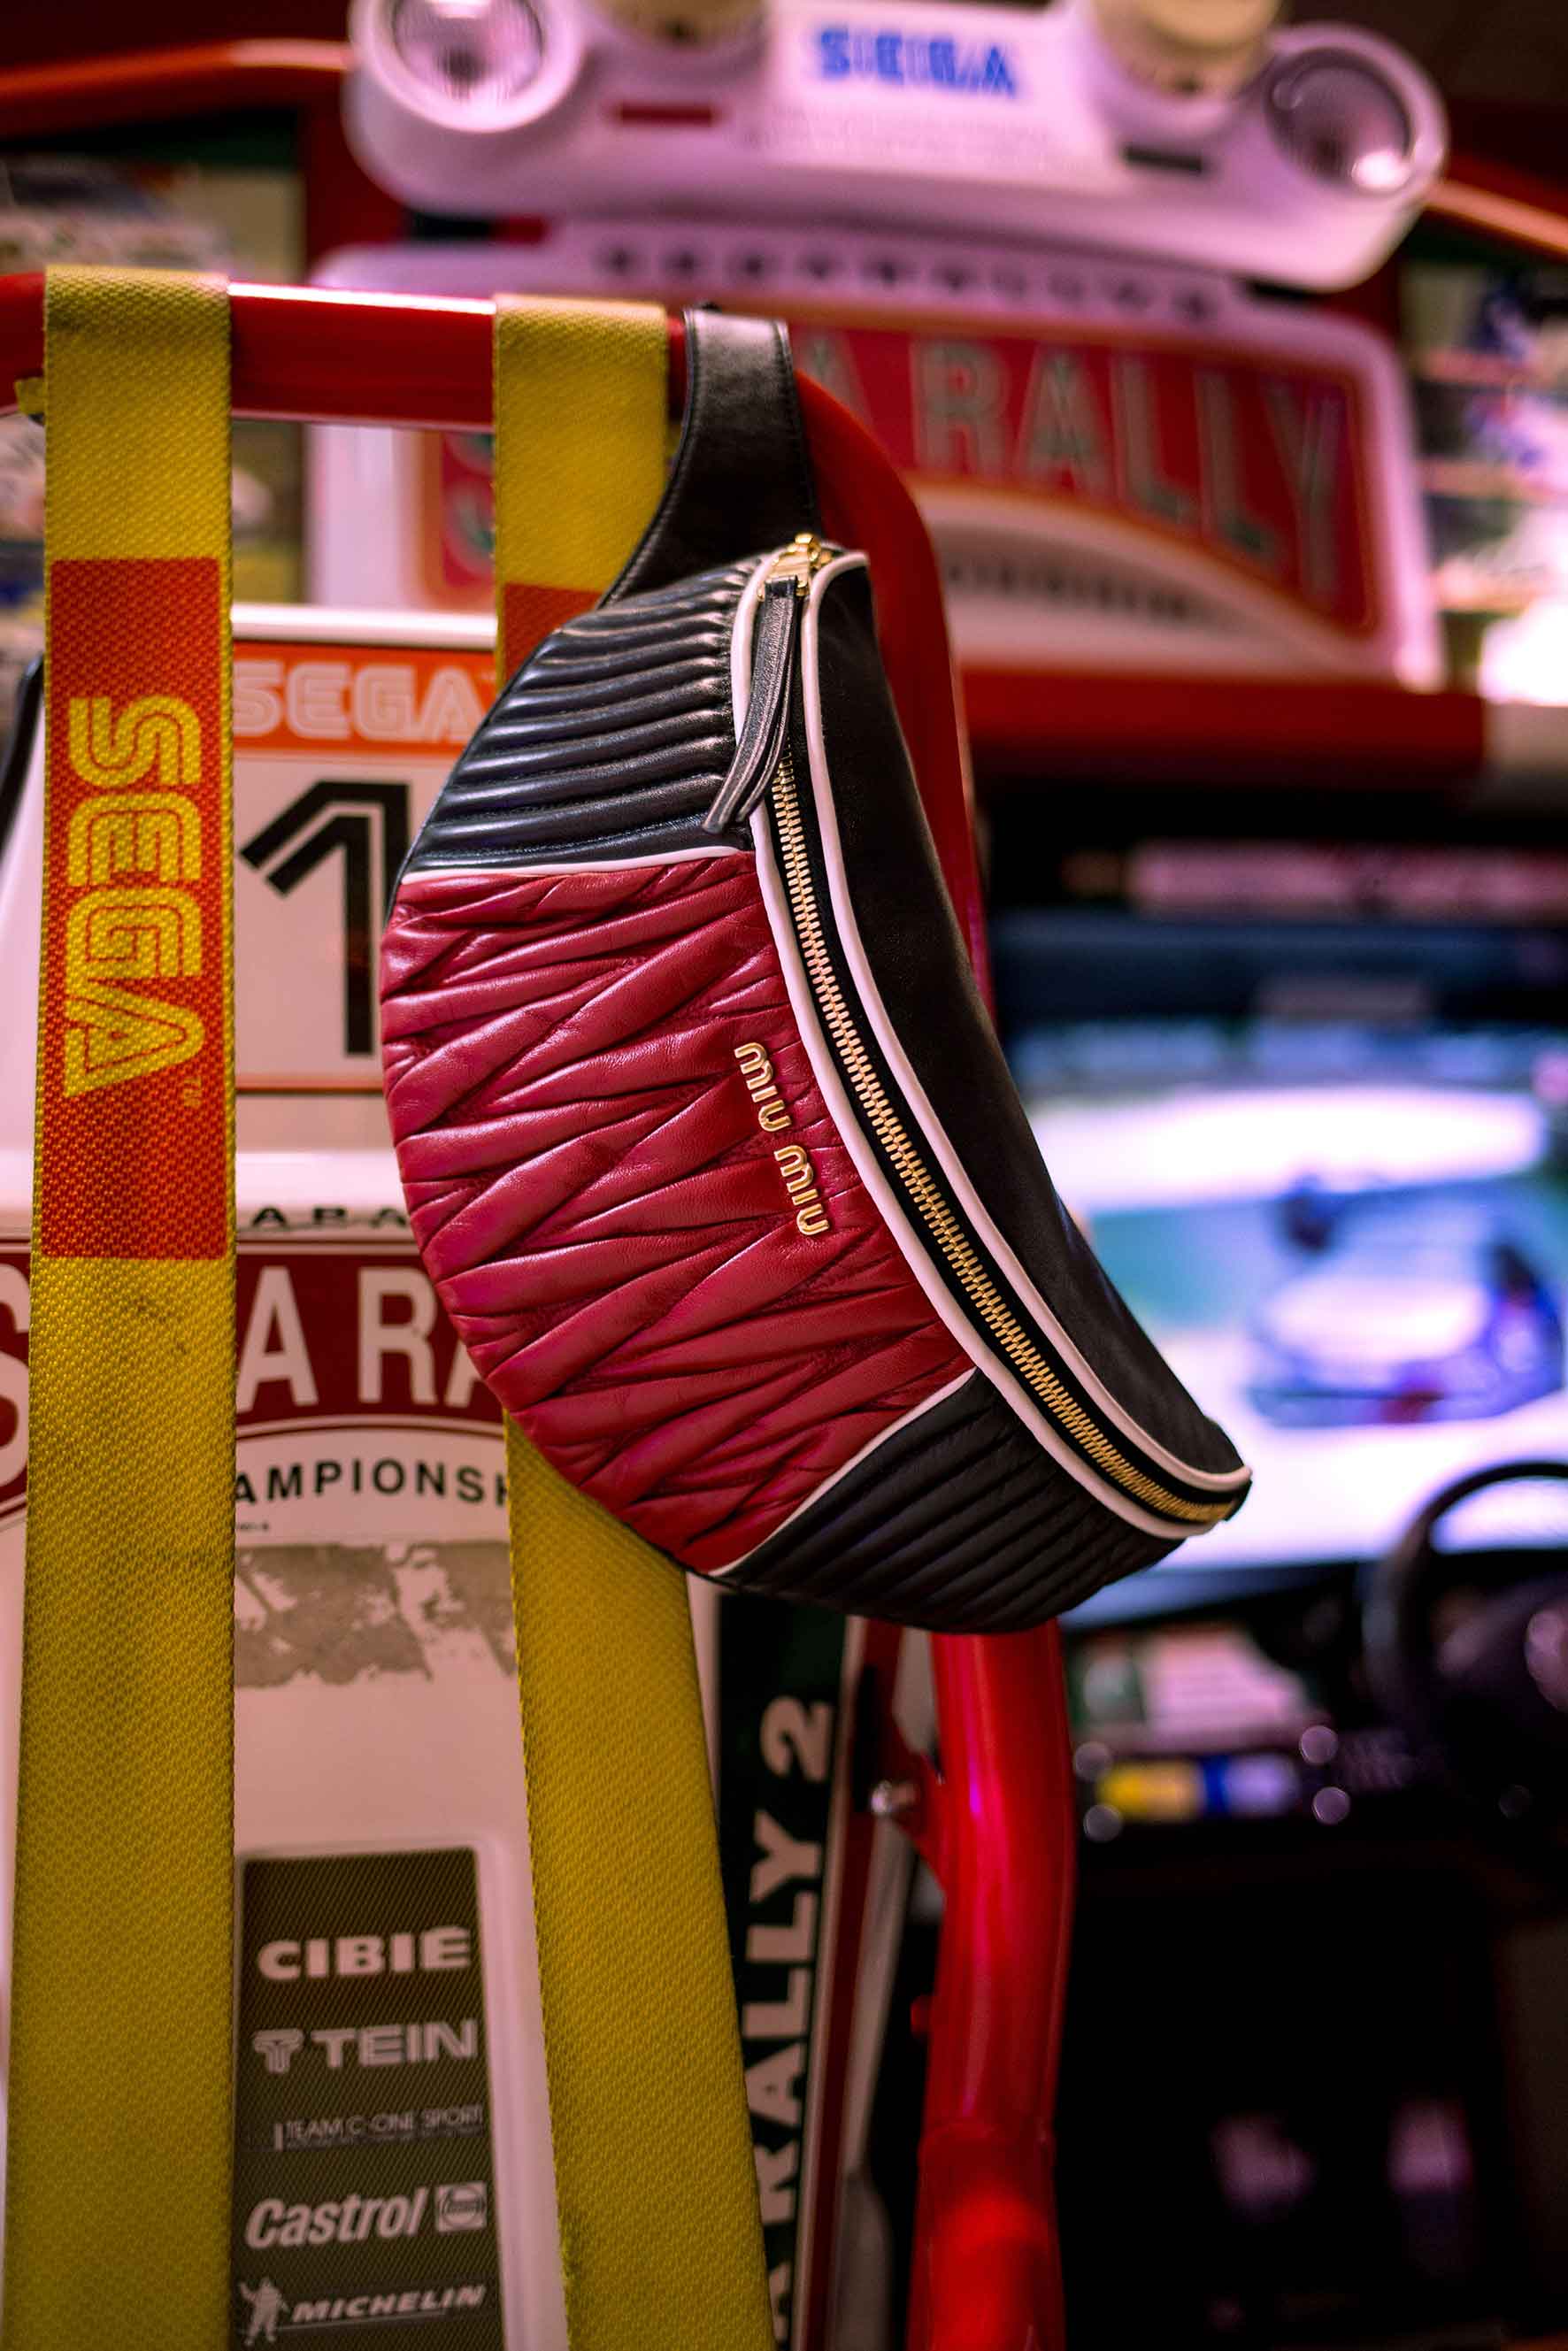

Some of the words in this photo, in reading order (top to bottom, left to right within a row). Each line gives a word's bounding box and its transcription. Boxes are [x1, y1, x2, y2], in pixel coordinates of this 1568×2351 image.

[819, 27, 1019, 99] SEGA
[910, 334, 1347, 598] RALLY
[234, 659, 485, 744] SEGA
[64, 694, 206, 1098] SEGA
[239, 780, 410, 1056] 1
[759, 1695, 833, 1782] 2
[310, 2018, 479, 2069] TEIN
[244, 2186, 429, 2249] Castrol
[292, 2283, 487, 2324] MICHELIN
